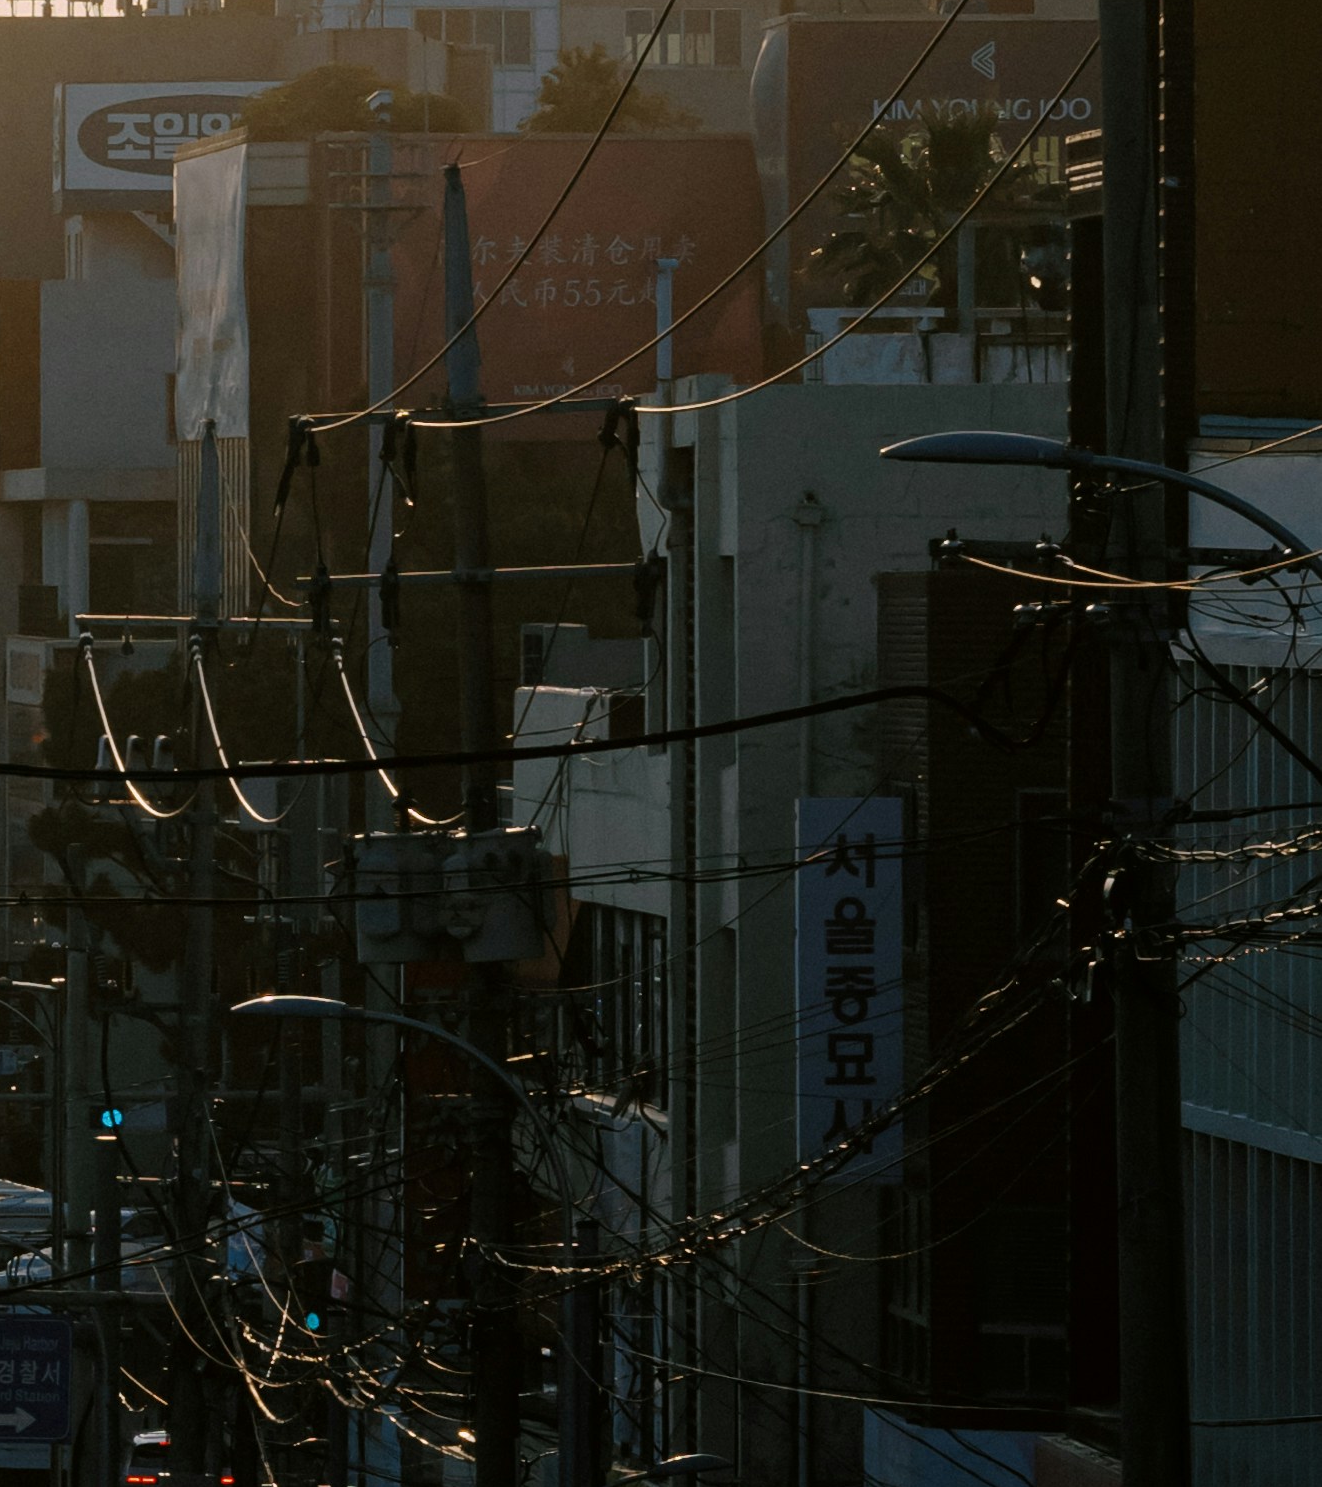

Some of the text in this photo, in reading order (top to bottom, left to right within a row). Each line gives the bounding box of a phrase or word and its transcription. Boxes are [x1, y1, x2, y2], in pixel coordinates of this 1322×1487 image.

[872, 98, 922, 121] KIM
[439, 233, 697, 267] 尔夫装清仓甩卖
